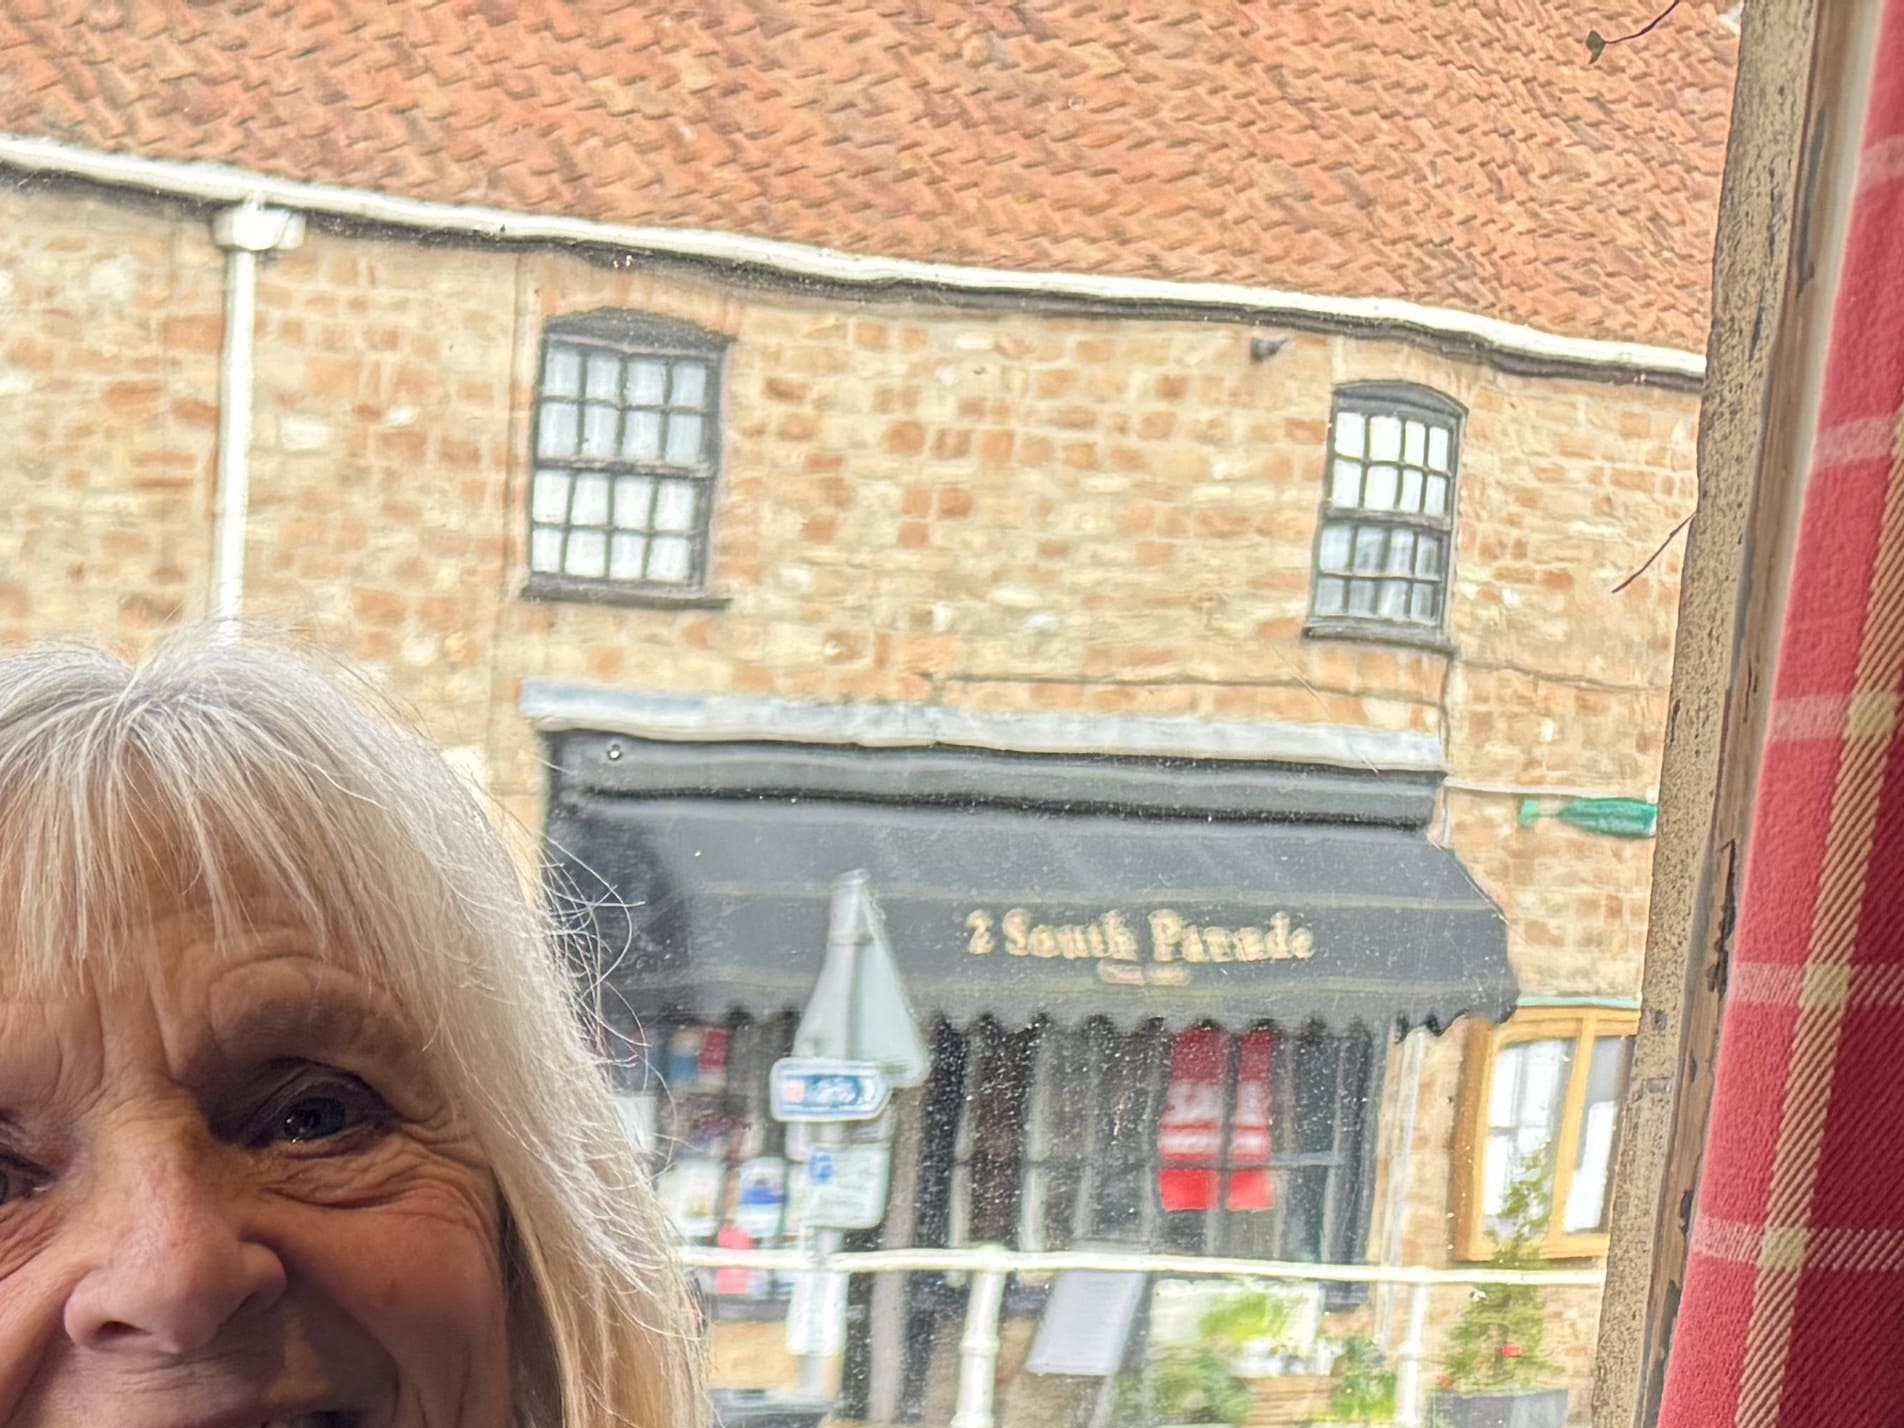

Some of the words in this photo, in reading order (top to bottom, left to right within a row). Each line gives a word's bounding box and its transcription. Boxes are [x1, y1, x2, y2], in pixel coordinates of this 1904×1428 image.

[966, 909, 993, 955] 2
[1002, 908, 1138, 961] South
[1148, 909, 1314, 963] Parade
